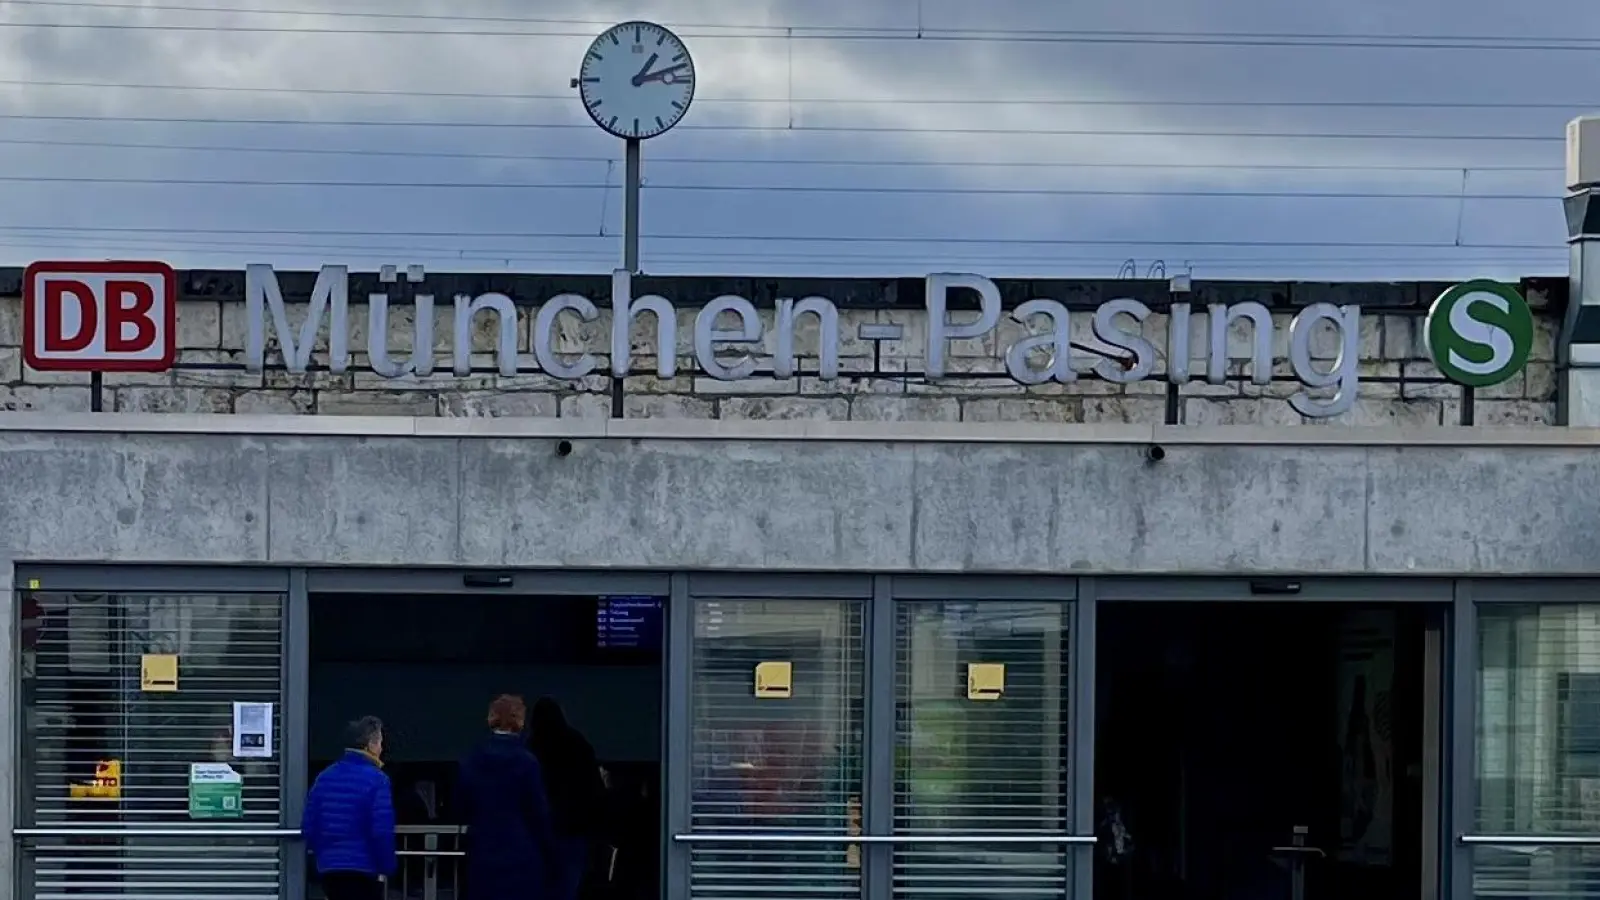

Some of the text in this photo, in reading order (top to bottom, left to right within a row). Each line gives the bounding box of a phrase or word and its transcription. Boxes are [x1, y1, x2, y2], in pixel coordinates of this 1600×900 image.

[43, 280, 157, 353] DB
[246, 264, 1361, 417] München-Pasing
[1448, 290, 1515, 374] S
